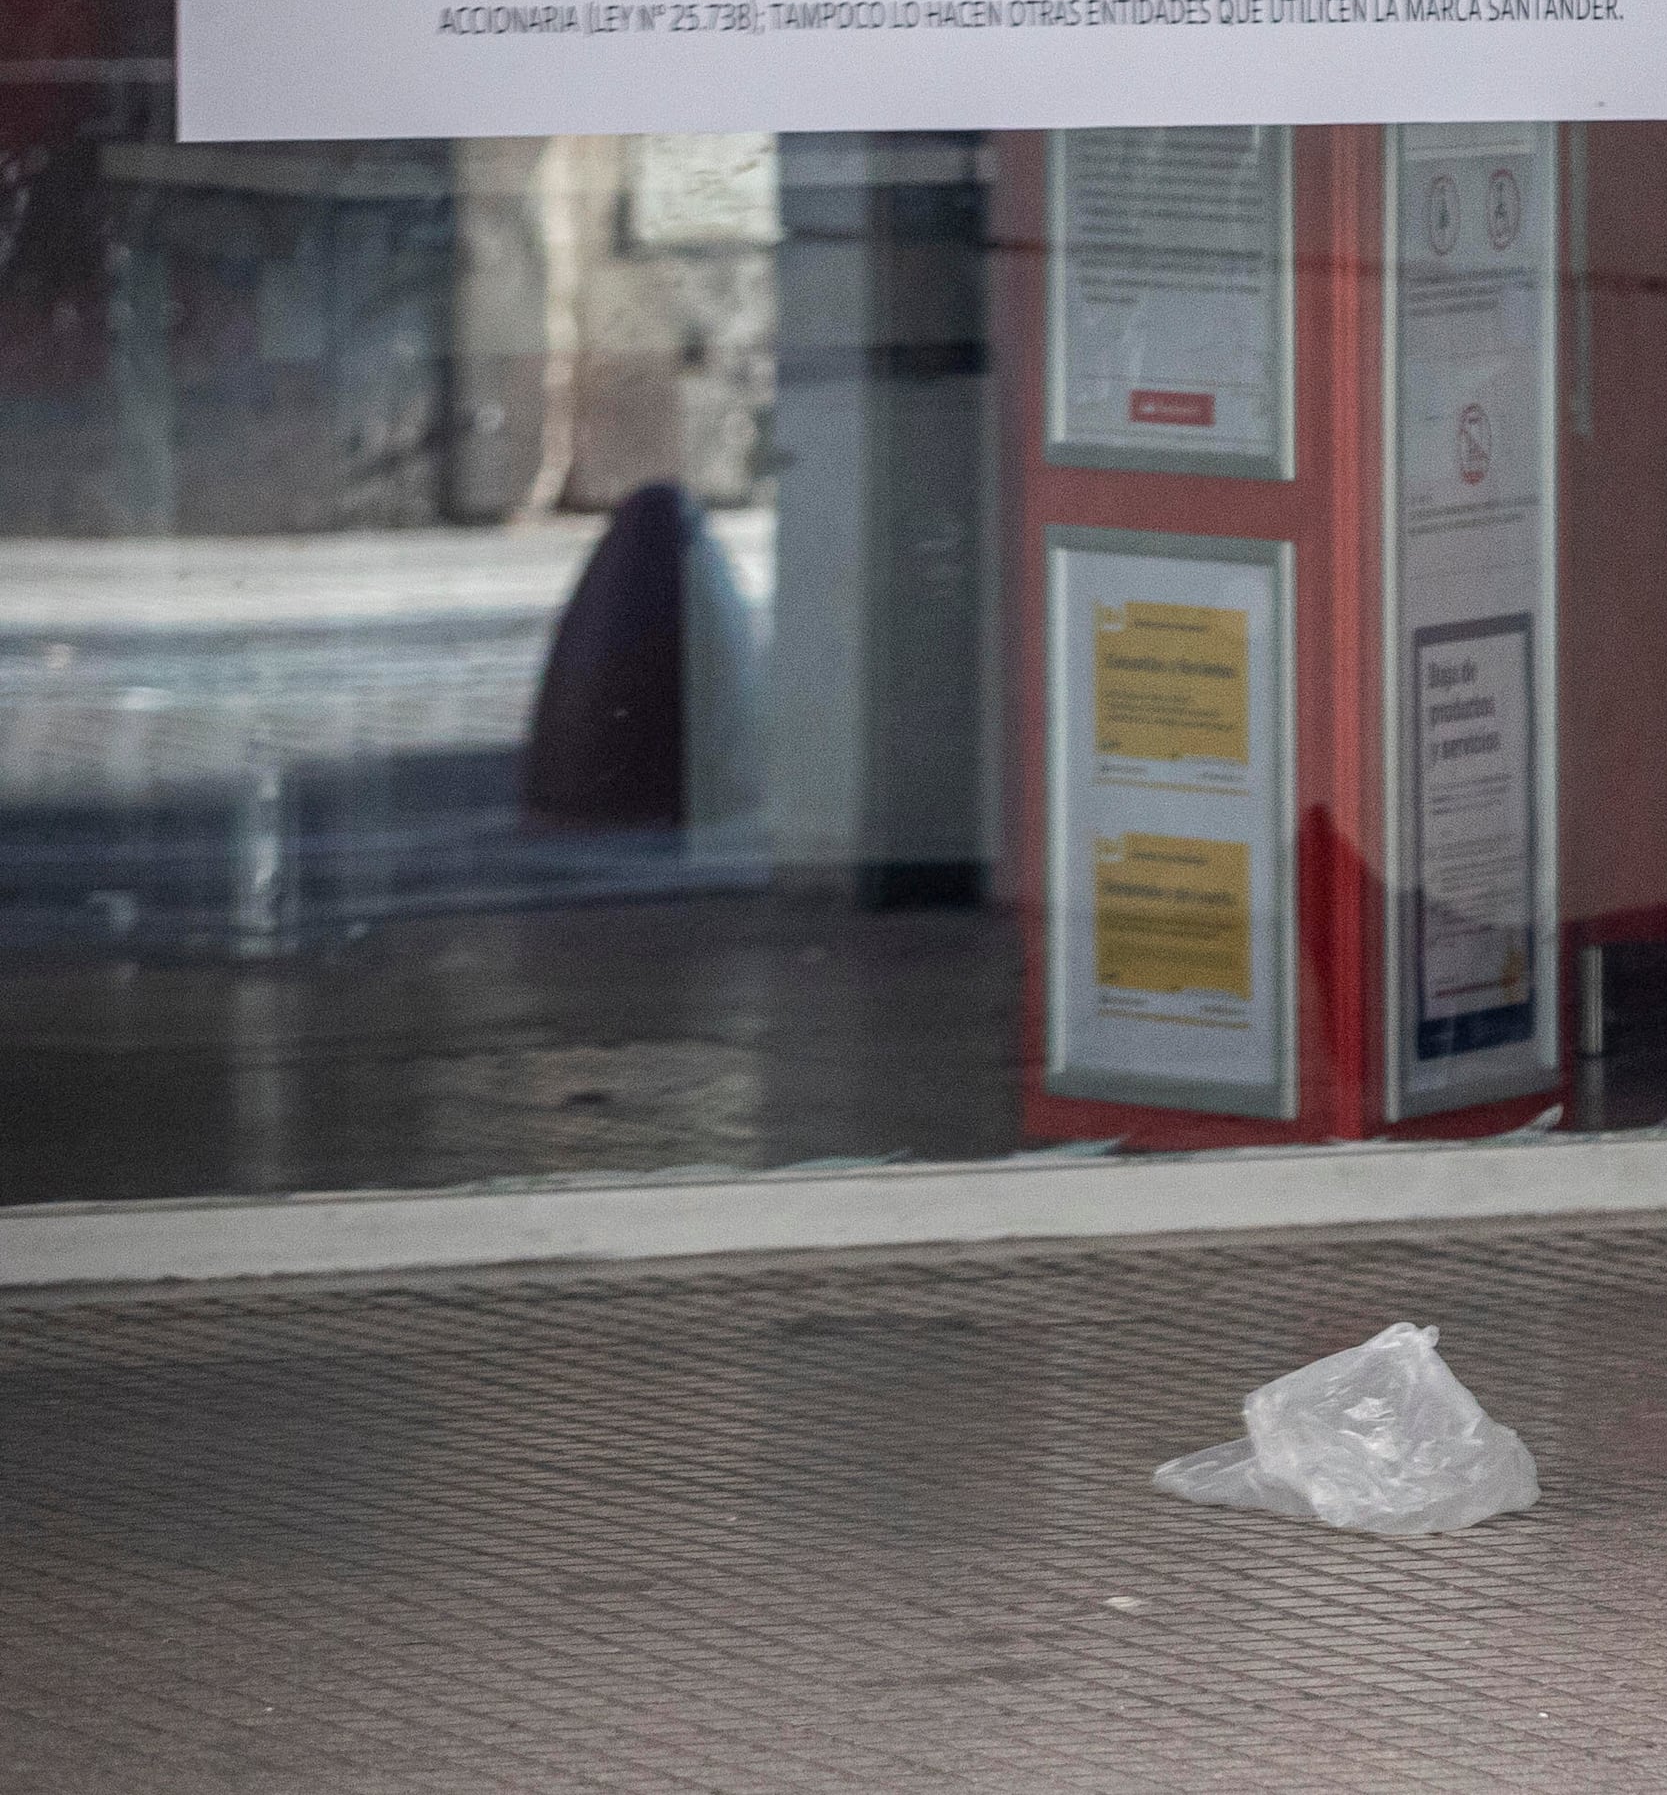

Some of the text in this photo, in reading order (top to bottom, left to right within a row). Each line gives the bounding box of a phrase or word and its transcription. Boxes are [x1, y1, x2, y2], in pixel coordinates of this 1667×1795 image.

[440, 5, 578, 35] ACCIONARIA
[584, 1, 635, 36] (LEY
[768, 1, 886, 30] TAMPOCO
[889, 1, 920, 29] LO
[927, 0, 1001, 29] HACEN
[1008, 0, 1080, 27] OTRAS
